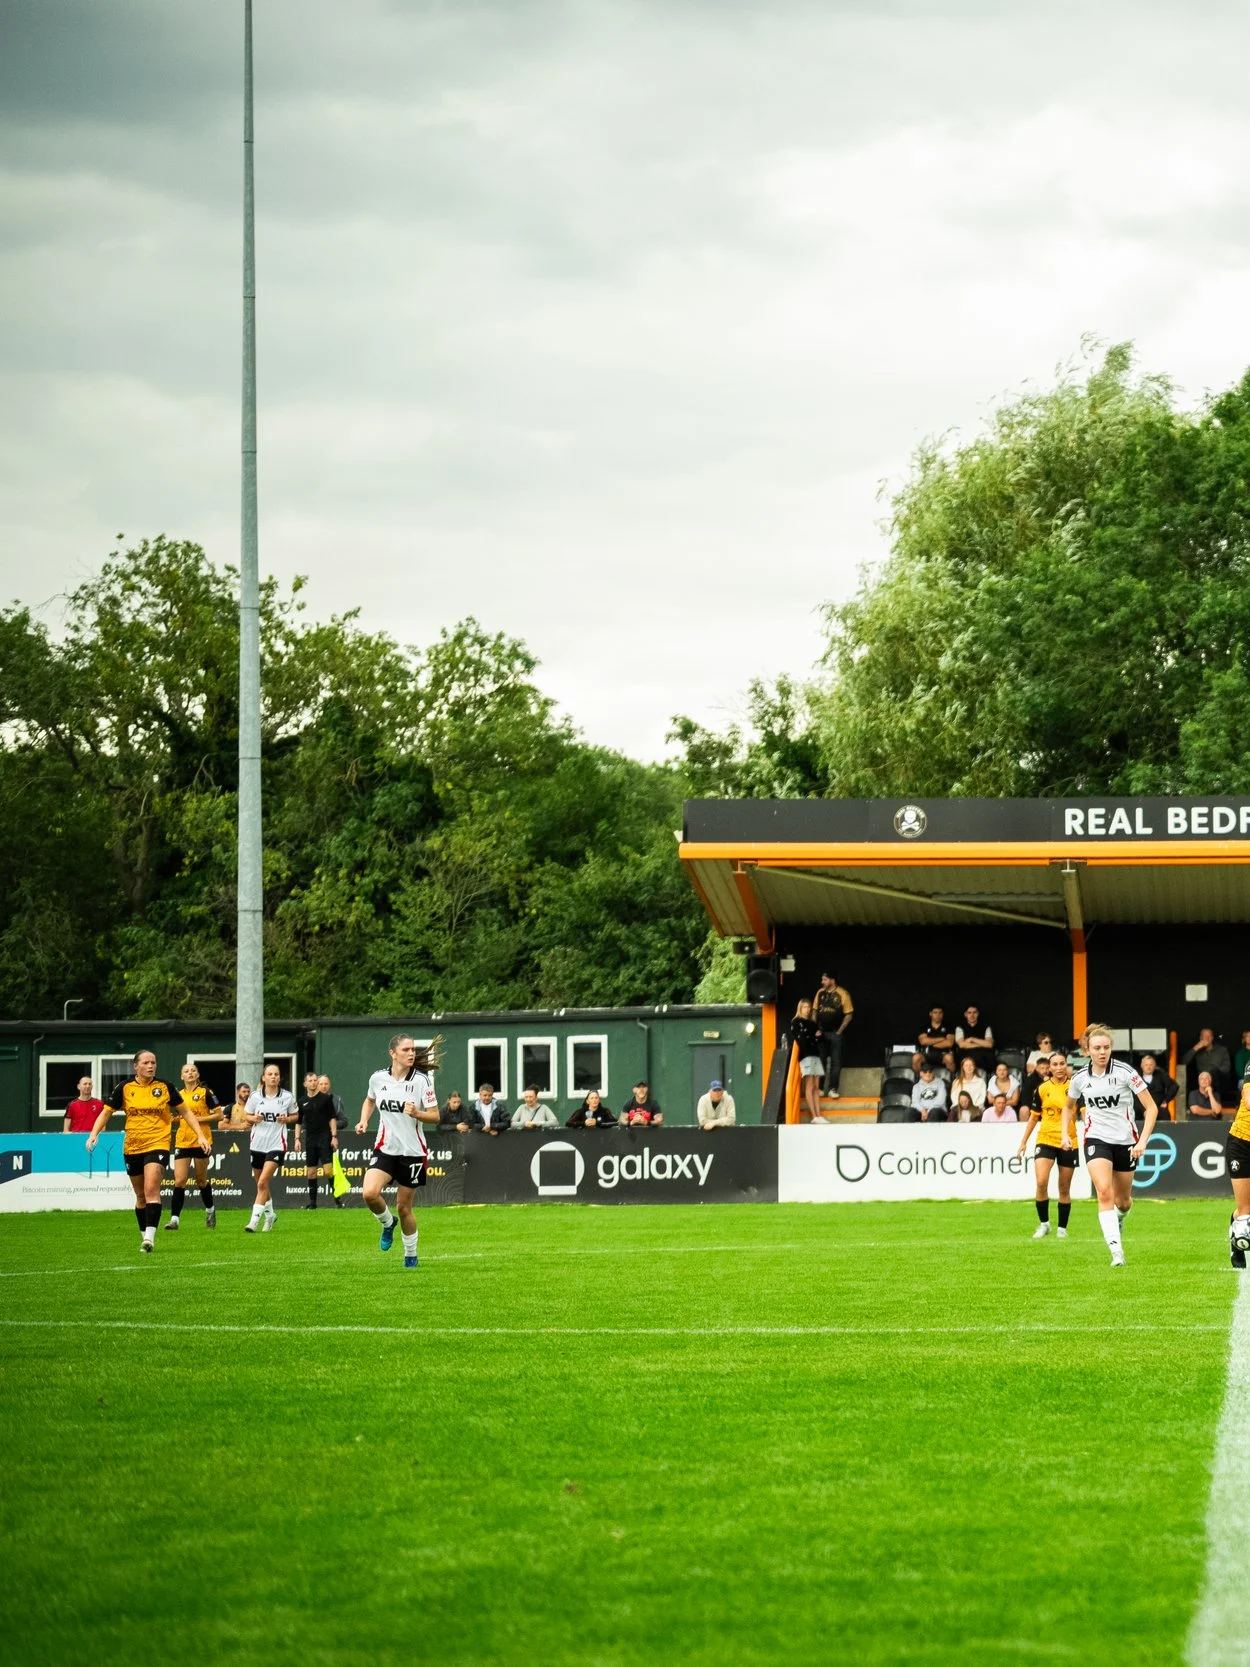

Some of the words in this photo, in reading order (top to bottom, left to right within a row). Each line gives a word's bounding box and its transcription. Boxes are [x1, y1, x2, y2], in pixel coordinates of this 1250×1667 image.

[1064, 807, 1153, 835] REAL
[1087, 1093, 1121, 1110] AEW
[342, 1149, 359, 1160] for
[437, 1151, 453, 1160] us
[408, 1162, 424, 1179] 17
[597, 1147, 714, 1189] galaxy
[878, 1151, 1034, 1176] CoinCorner
[210, 1178, 234, 1187] Pools,
